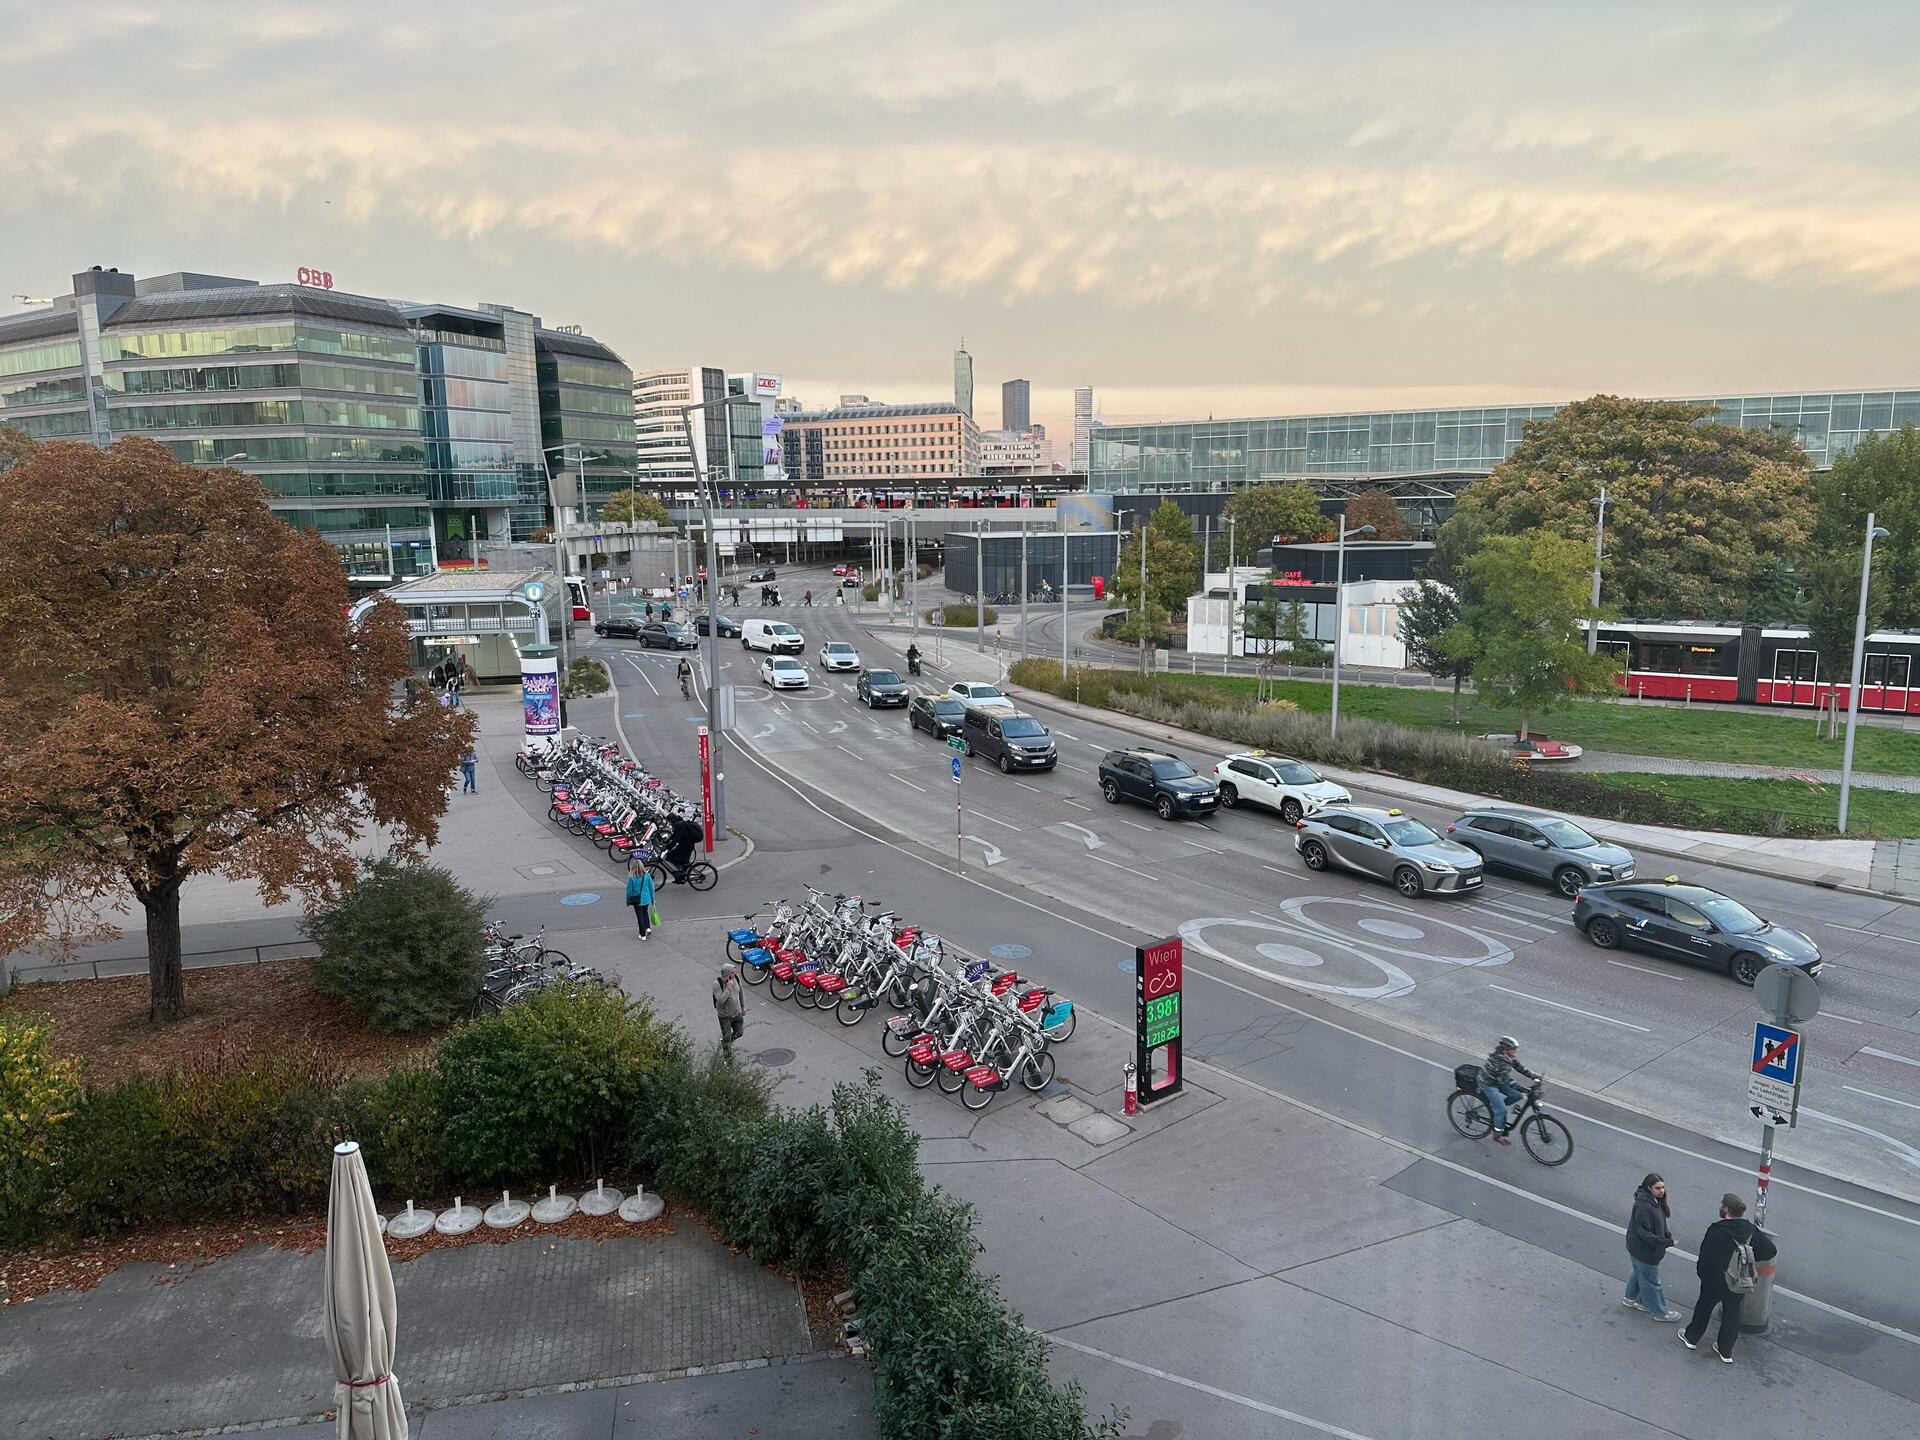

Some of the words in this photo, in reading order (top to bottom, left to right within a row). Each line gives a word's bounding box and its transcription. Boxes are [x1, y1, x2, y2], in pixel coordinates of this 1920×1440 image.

[298, 267, 333, 288] ÖBB
[759, 380, 775, 388] WKO
[528, 587, 541, 600] U
[1148, 949, 1177, 967] Wien
[1147, 997, 1178, 1024] 3.981
